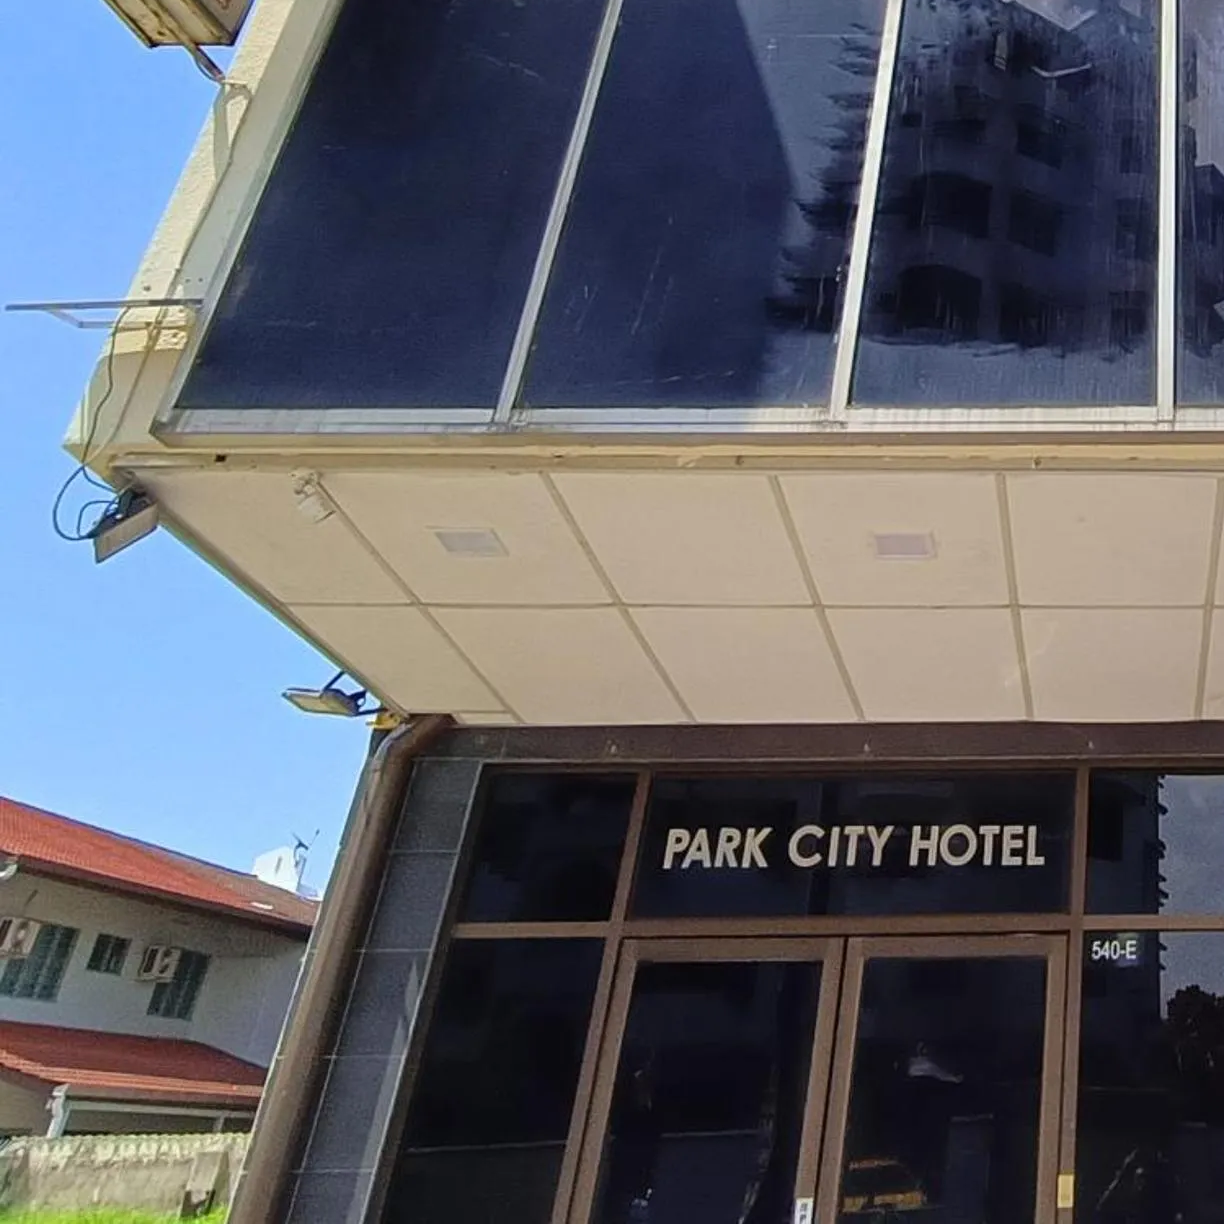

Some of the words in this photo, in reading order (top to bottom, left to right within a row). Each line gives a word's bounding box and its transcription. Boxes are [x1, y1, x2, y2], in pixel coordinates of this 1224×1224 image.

[662, 826, 773, 870] PARK
[787, 823, 894, 868] CITY
[908, 823, 1046, 867] HOTEL
[1091, 939, 1138, 961] 540-E
